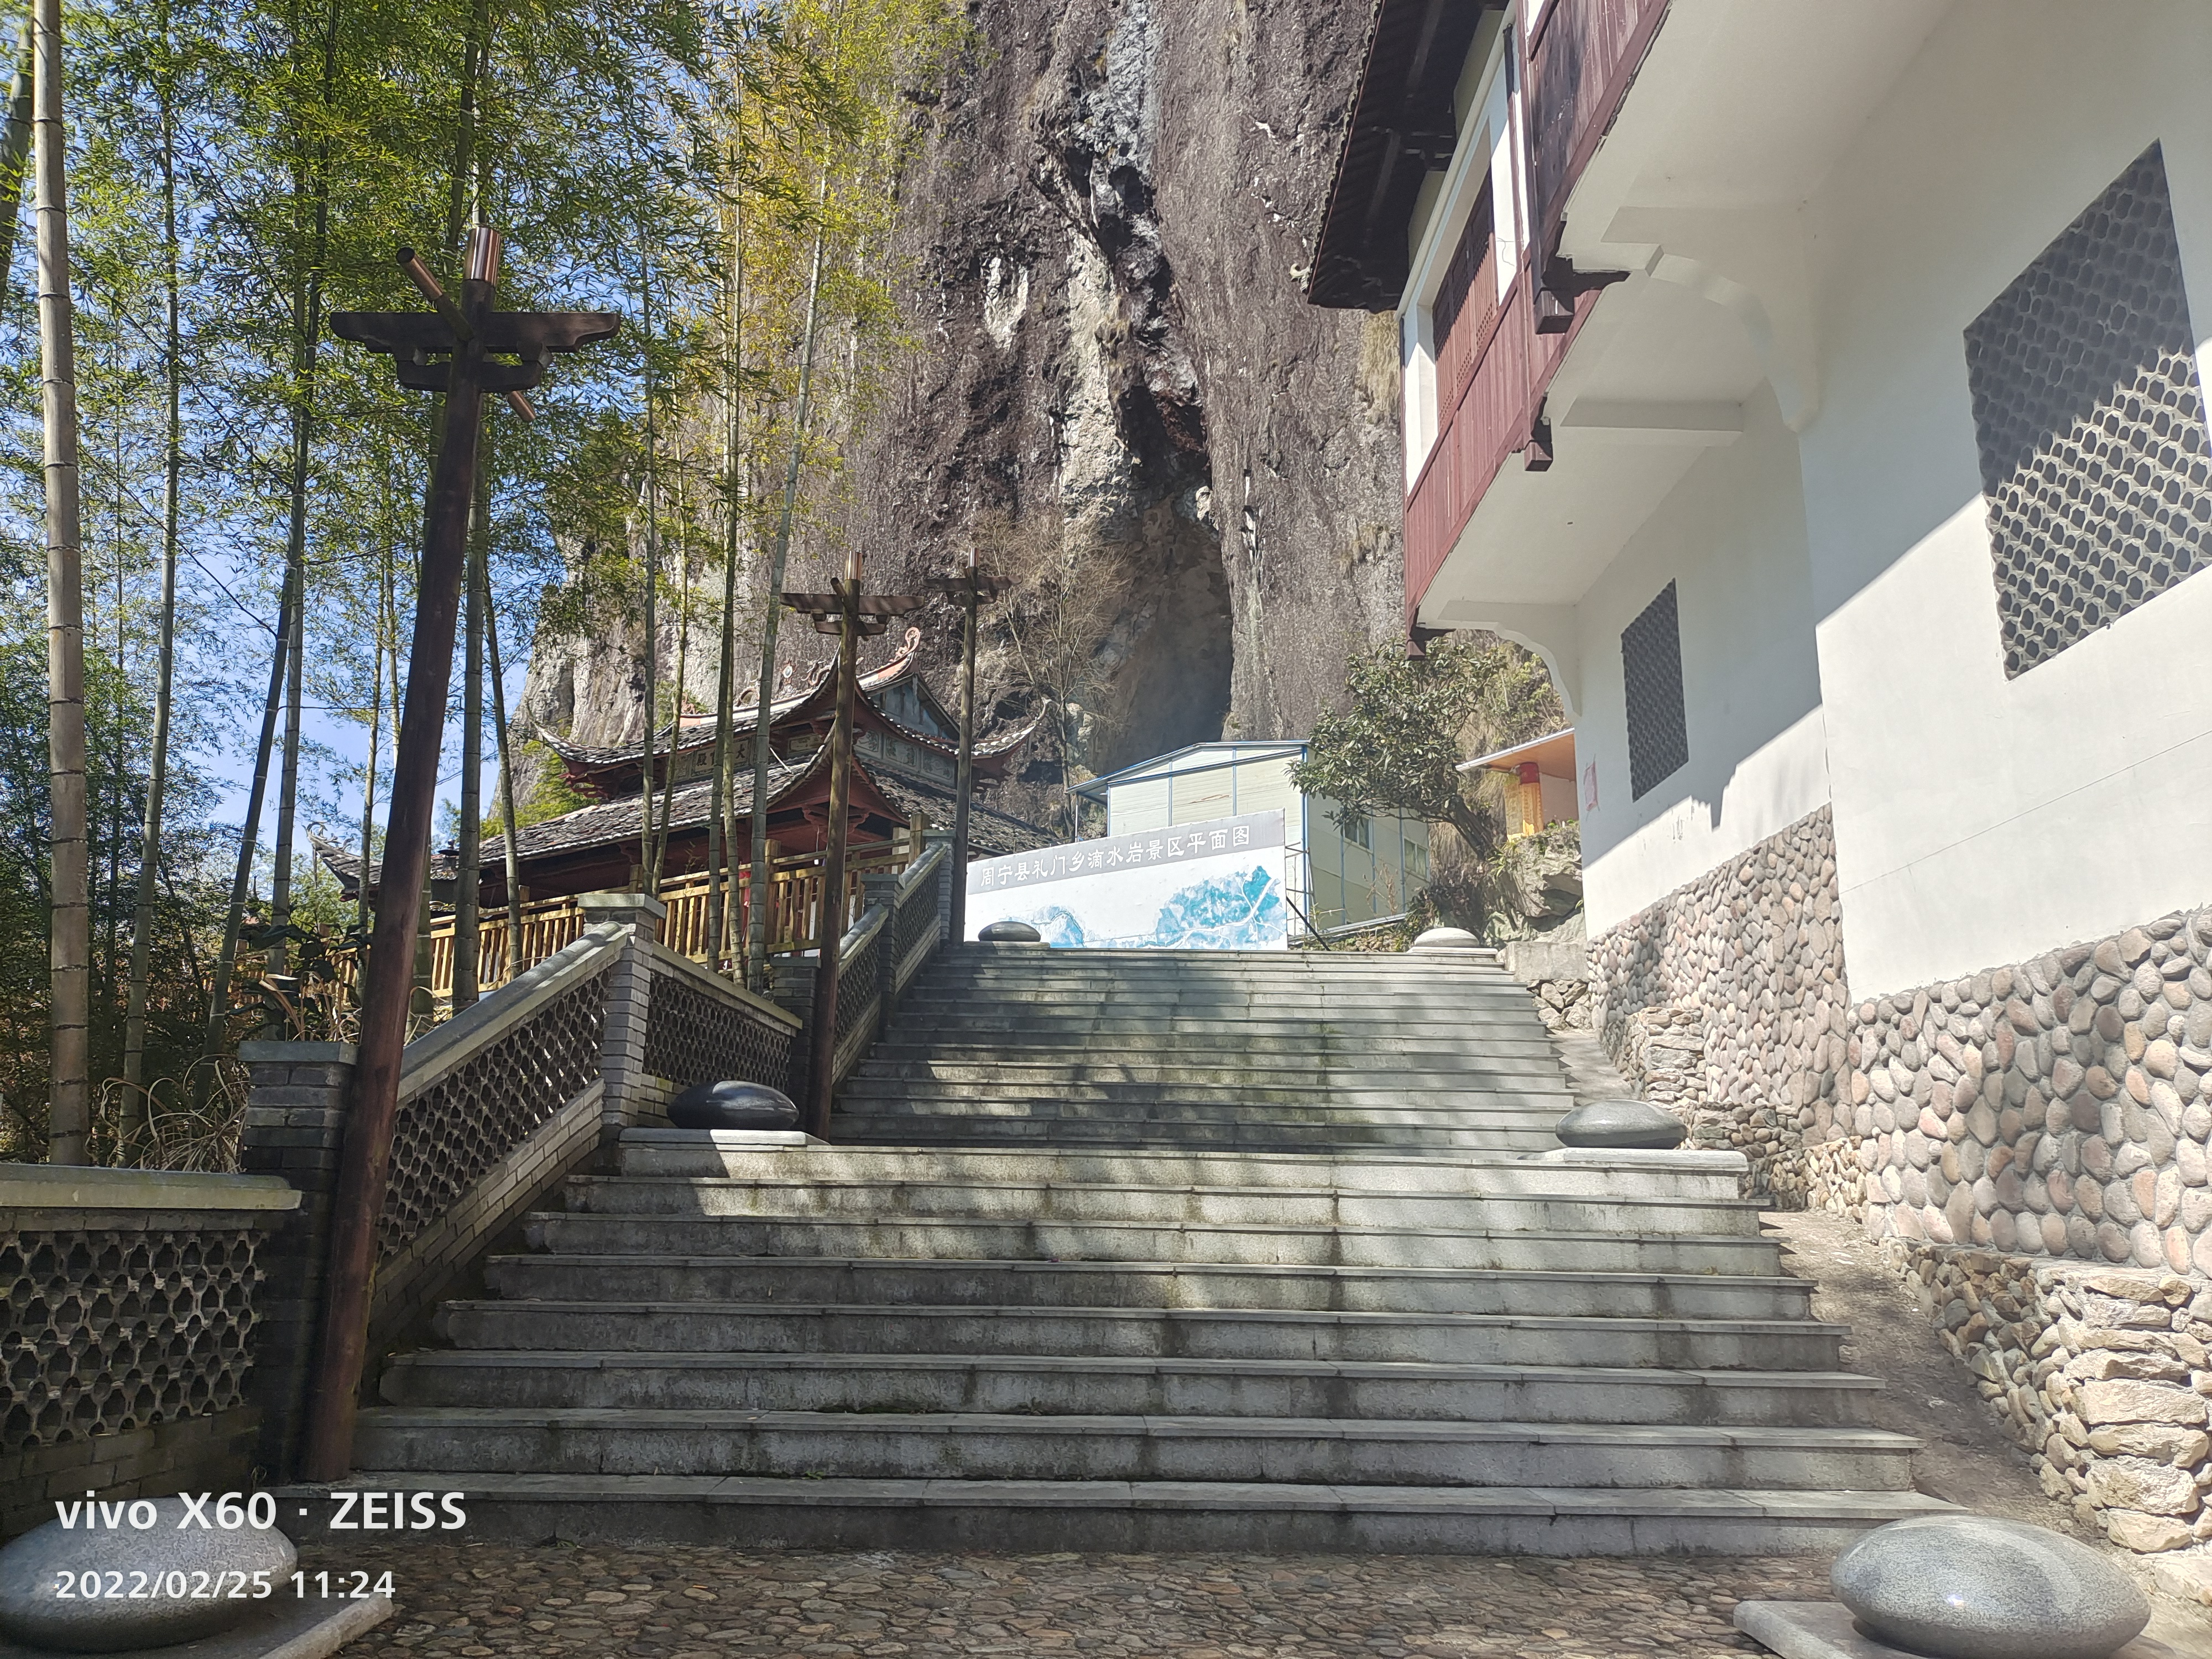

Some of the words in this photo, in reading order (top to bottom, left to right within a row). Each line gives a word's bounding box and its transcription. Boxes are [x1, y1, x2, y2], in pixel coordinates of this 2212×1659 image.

[980, 826, 1250, 887] 周宁县礼门乡滴水岩景区平面图
